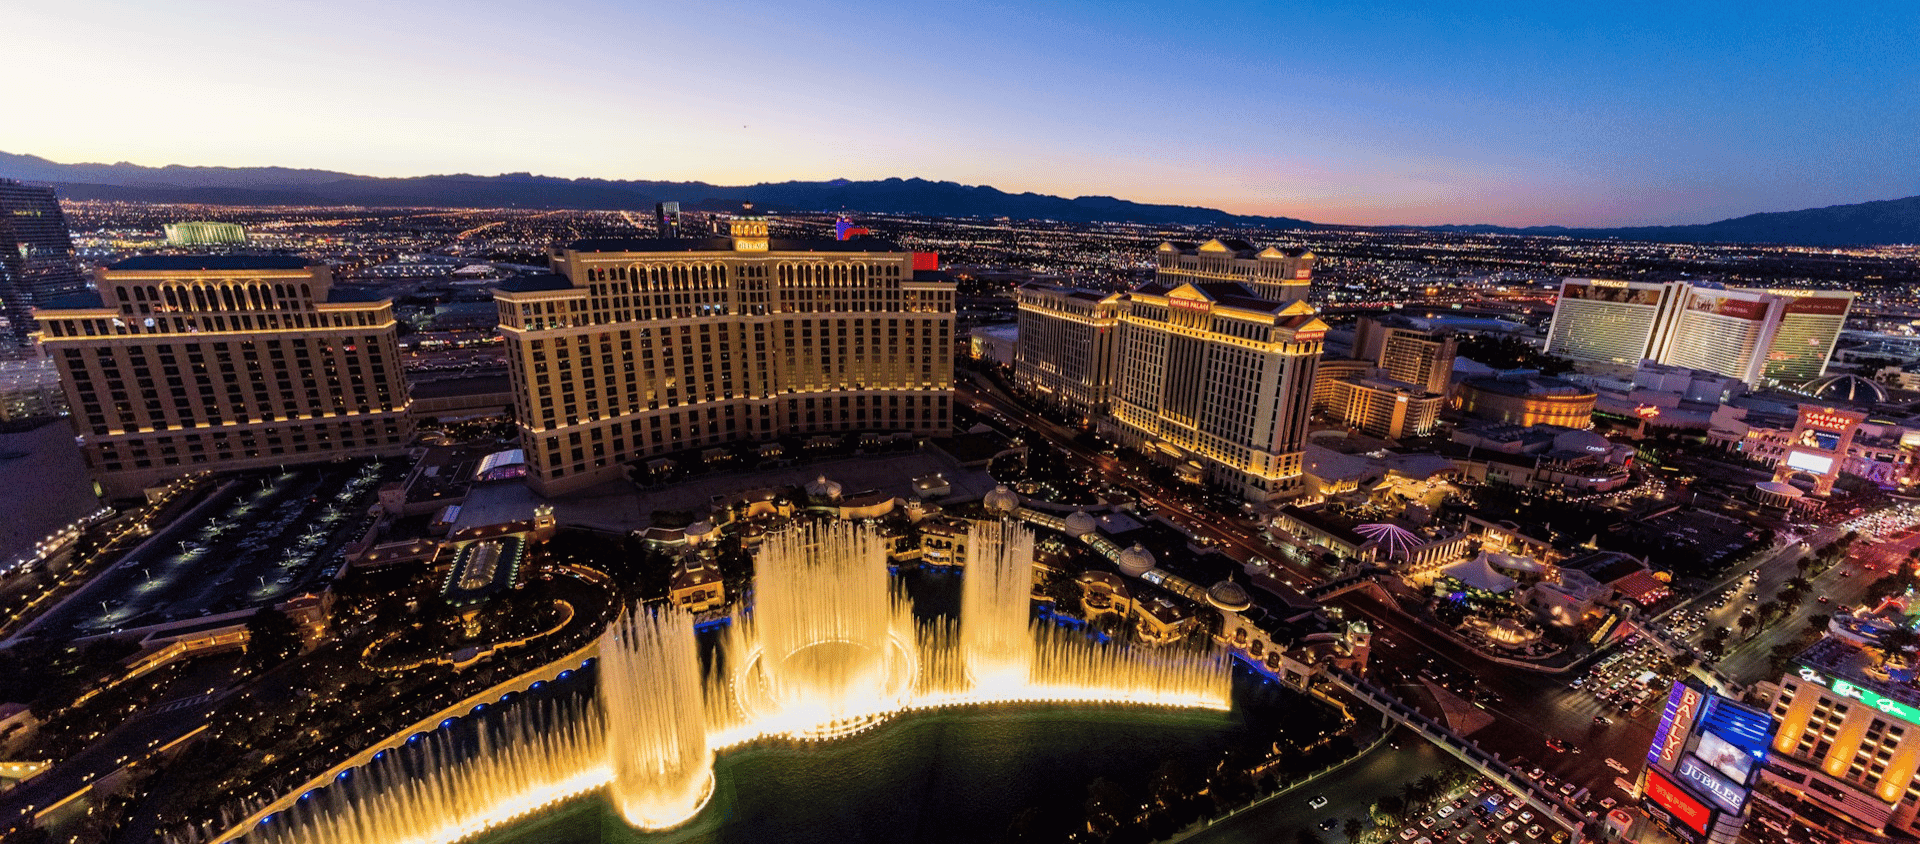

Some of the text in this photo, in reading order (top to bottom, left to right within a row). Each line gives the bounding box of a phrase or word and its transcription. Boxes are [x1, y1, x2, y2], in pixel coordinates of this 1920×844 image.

[1777, 288, 1815, 298] MIRAGE
[1805, 412, 1851, 425] CAESARS
[1805, 418, 1846, 430] PALACE
[1679, 763, 1743, 807] JUBILEE
